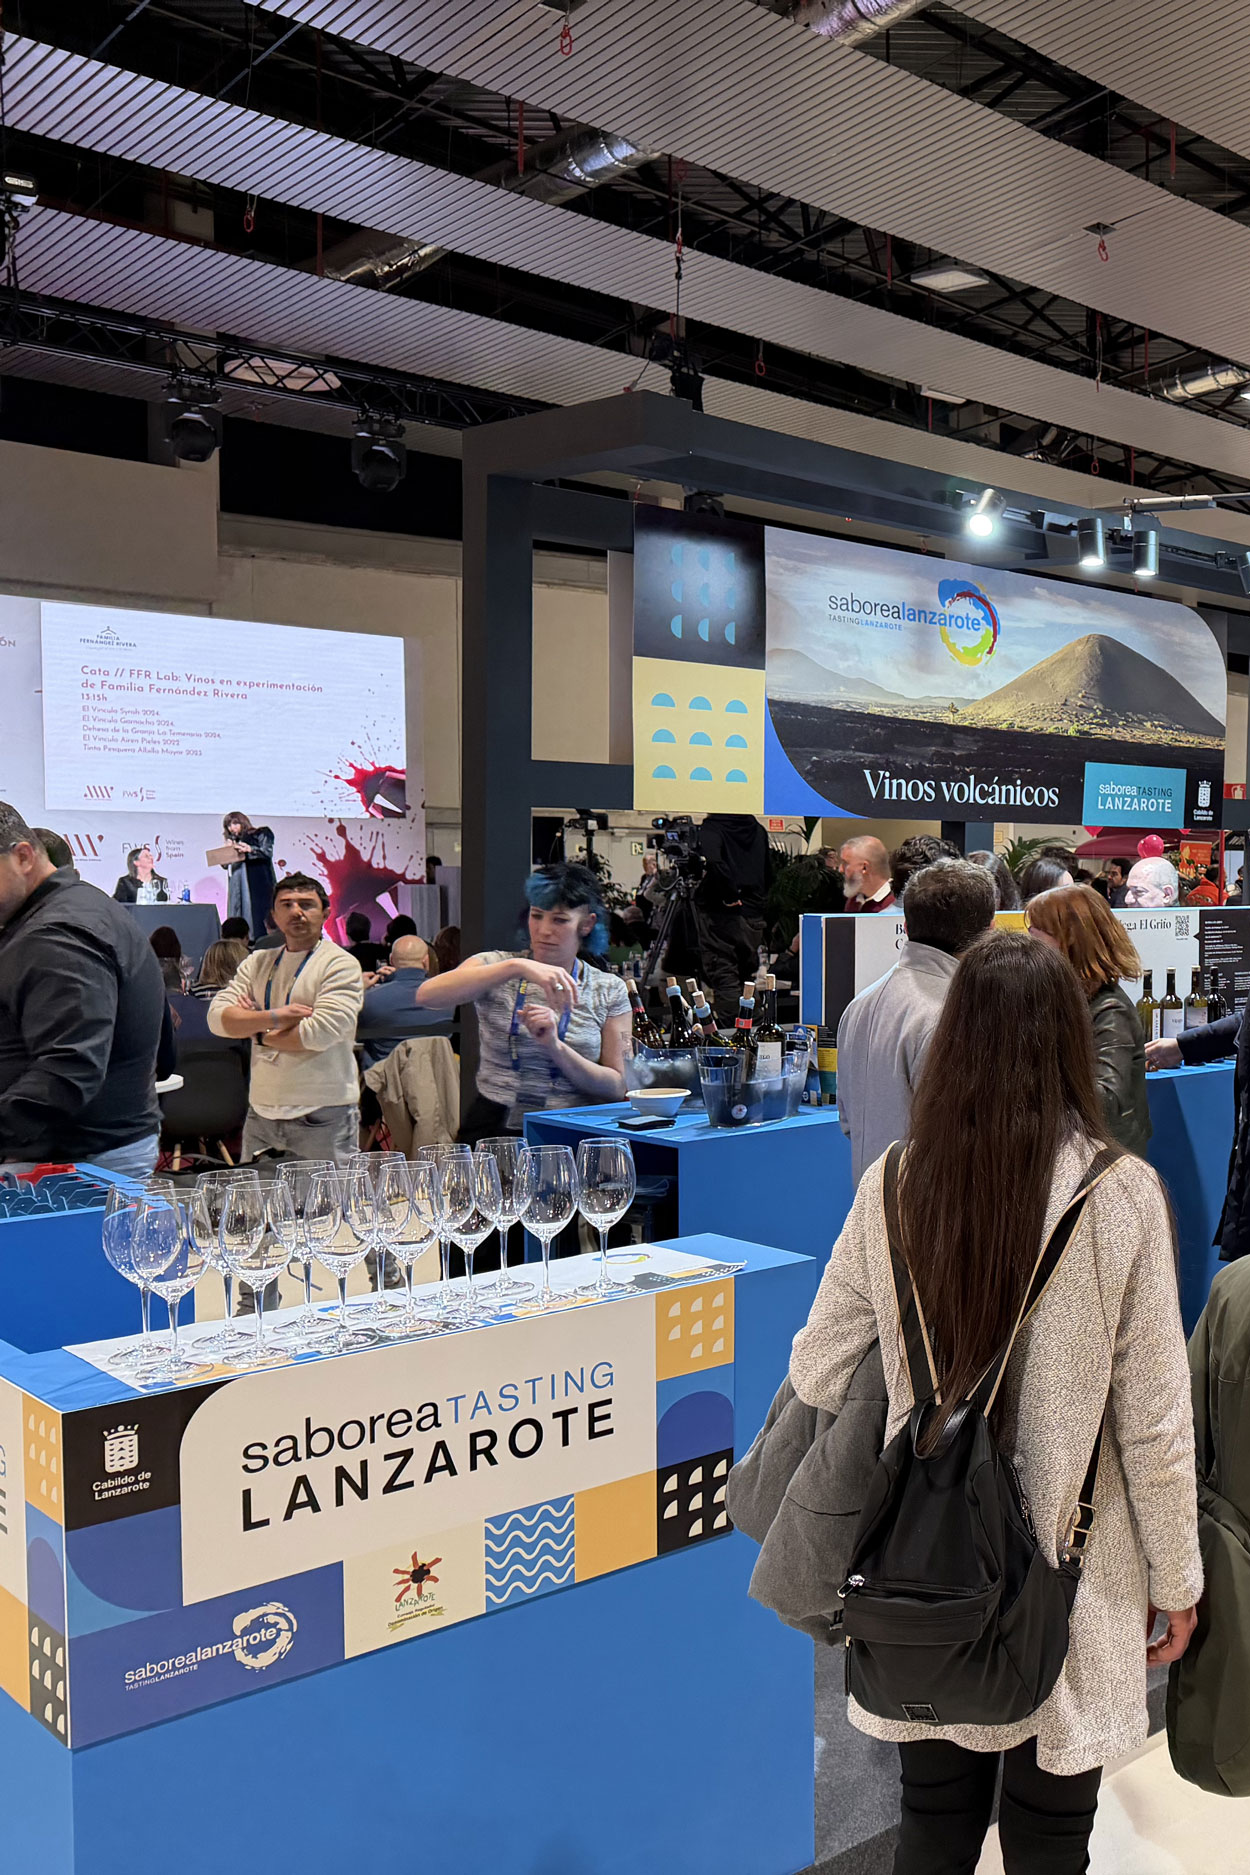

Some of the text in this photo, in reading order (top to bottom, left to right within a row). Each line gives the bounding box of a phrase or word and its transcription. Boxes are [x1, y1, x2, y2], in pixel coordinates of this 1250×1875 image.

[81, 665, 110, 676] Cata
[129, 669, 151, 680] FFR
[156, 671, 181, 682] Lab:
[185, 673, 215, 684] Vinos
[219, 678, 232, 686] en
[236, 680, 323, 693] experimentación
[81, 679, 248, 700] de Familia Fernández Rivera
[863, 769, 1060, 807] Vinos volcánicos
[1097, 797, 1172, 812] LANZAROTE
[1140, 919, 1148, 930] El
[242, 1398, 614, 1533] LANZAROTE
[92, 1471, 152, 1491] Cabildo de
[94, 1481, 150, 1501] Lanzarote
